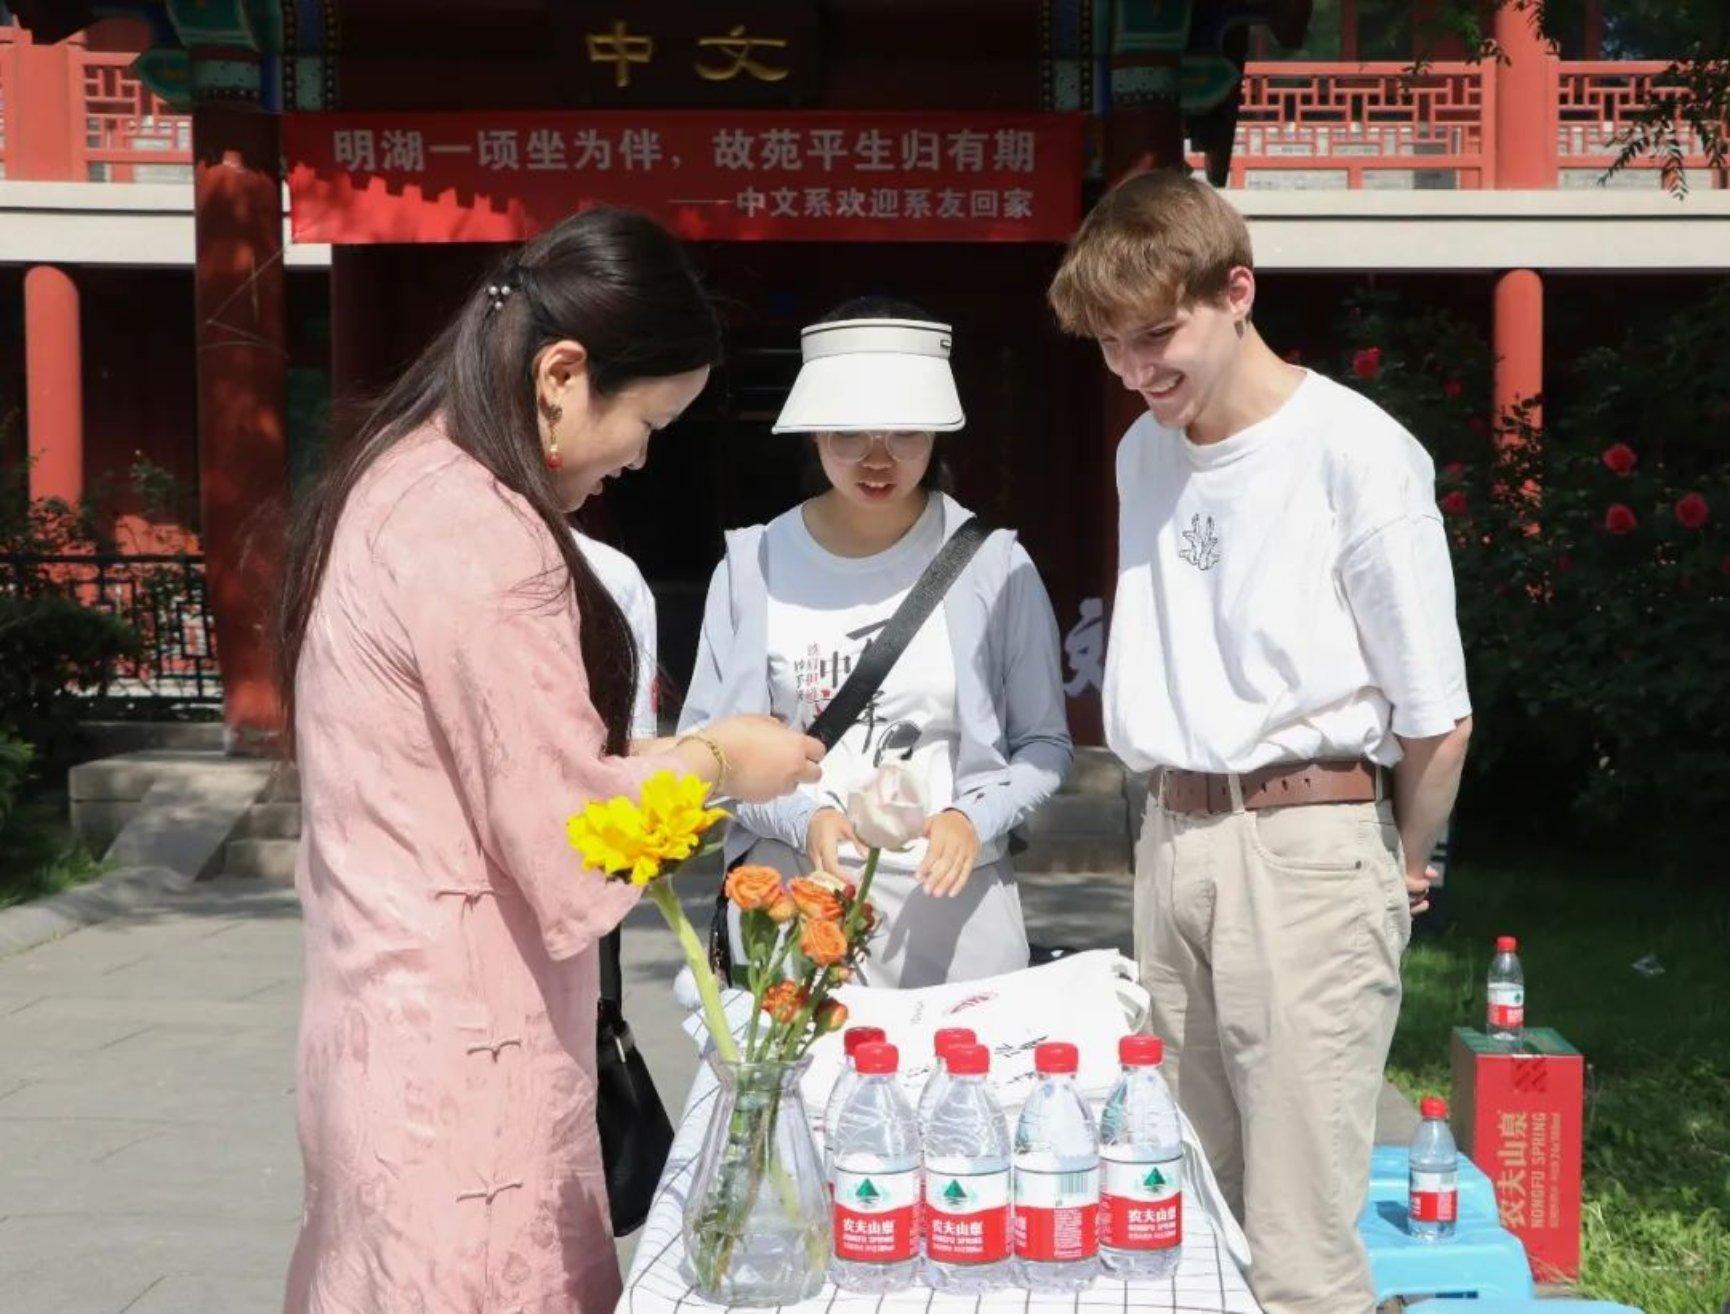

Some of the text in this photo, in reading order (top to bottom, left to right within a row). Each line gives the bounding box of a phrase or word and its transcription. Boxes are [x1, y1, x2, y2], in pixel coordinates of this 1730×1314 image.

[586, 20, 789, 88] 中文
[333, 128, 1036, 172] 明湖一顷坐为伴，故苑平生归有期
[1497, 1111, 1527, 1228] 农夫山泉
[1531, 1112, 1546, 1228] NONGFU SPRING
